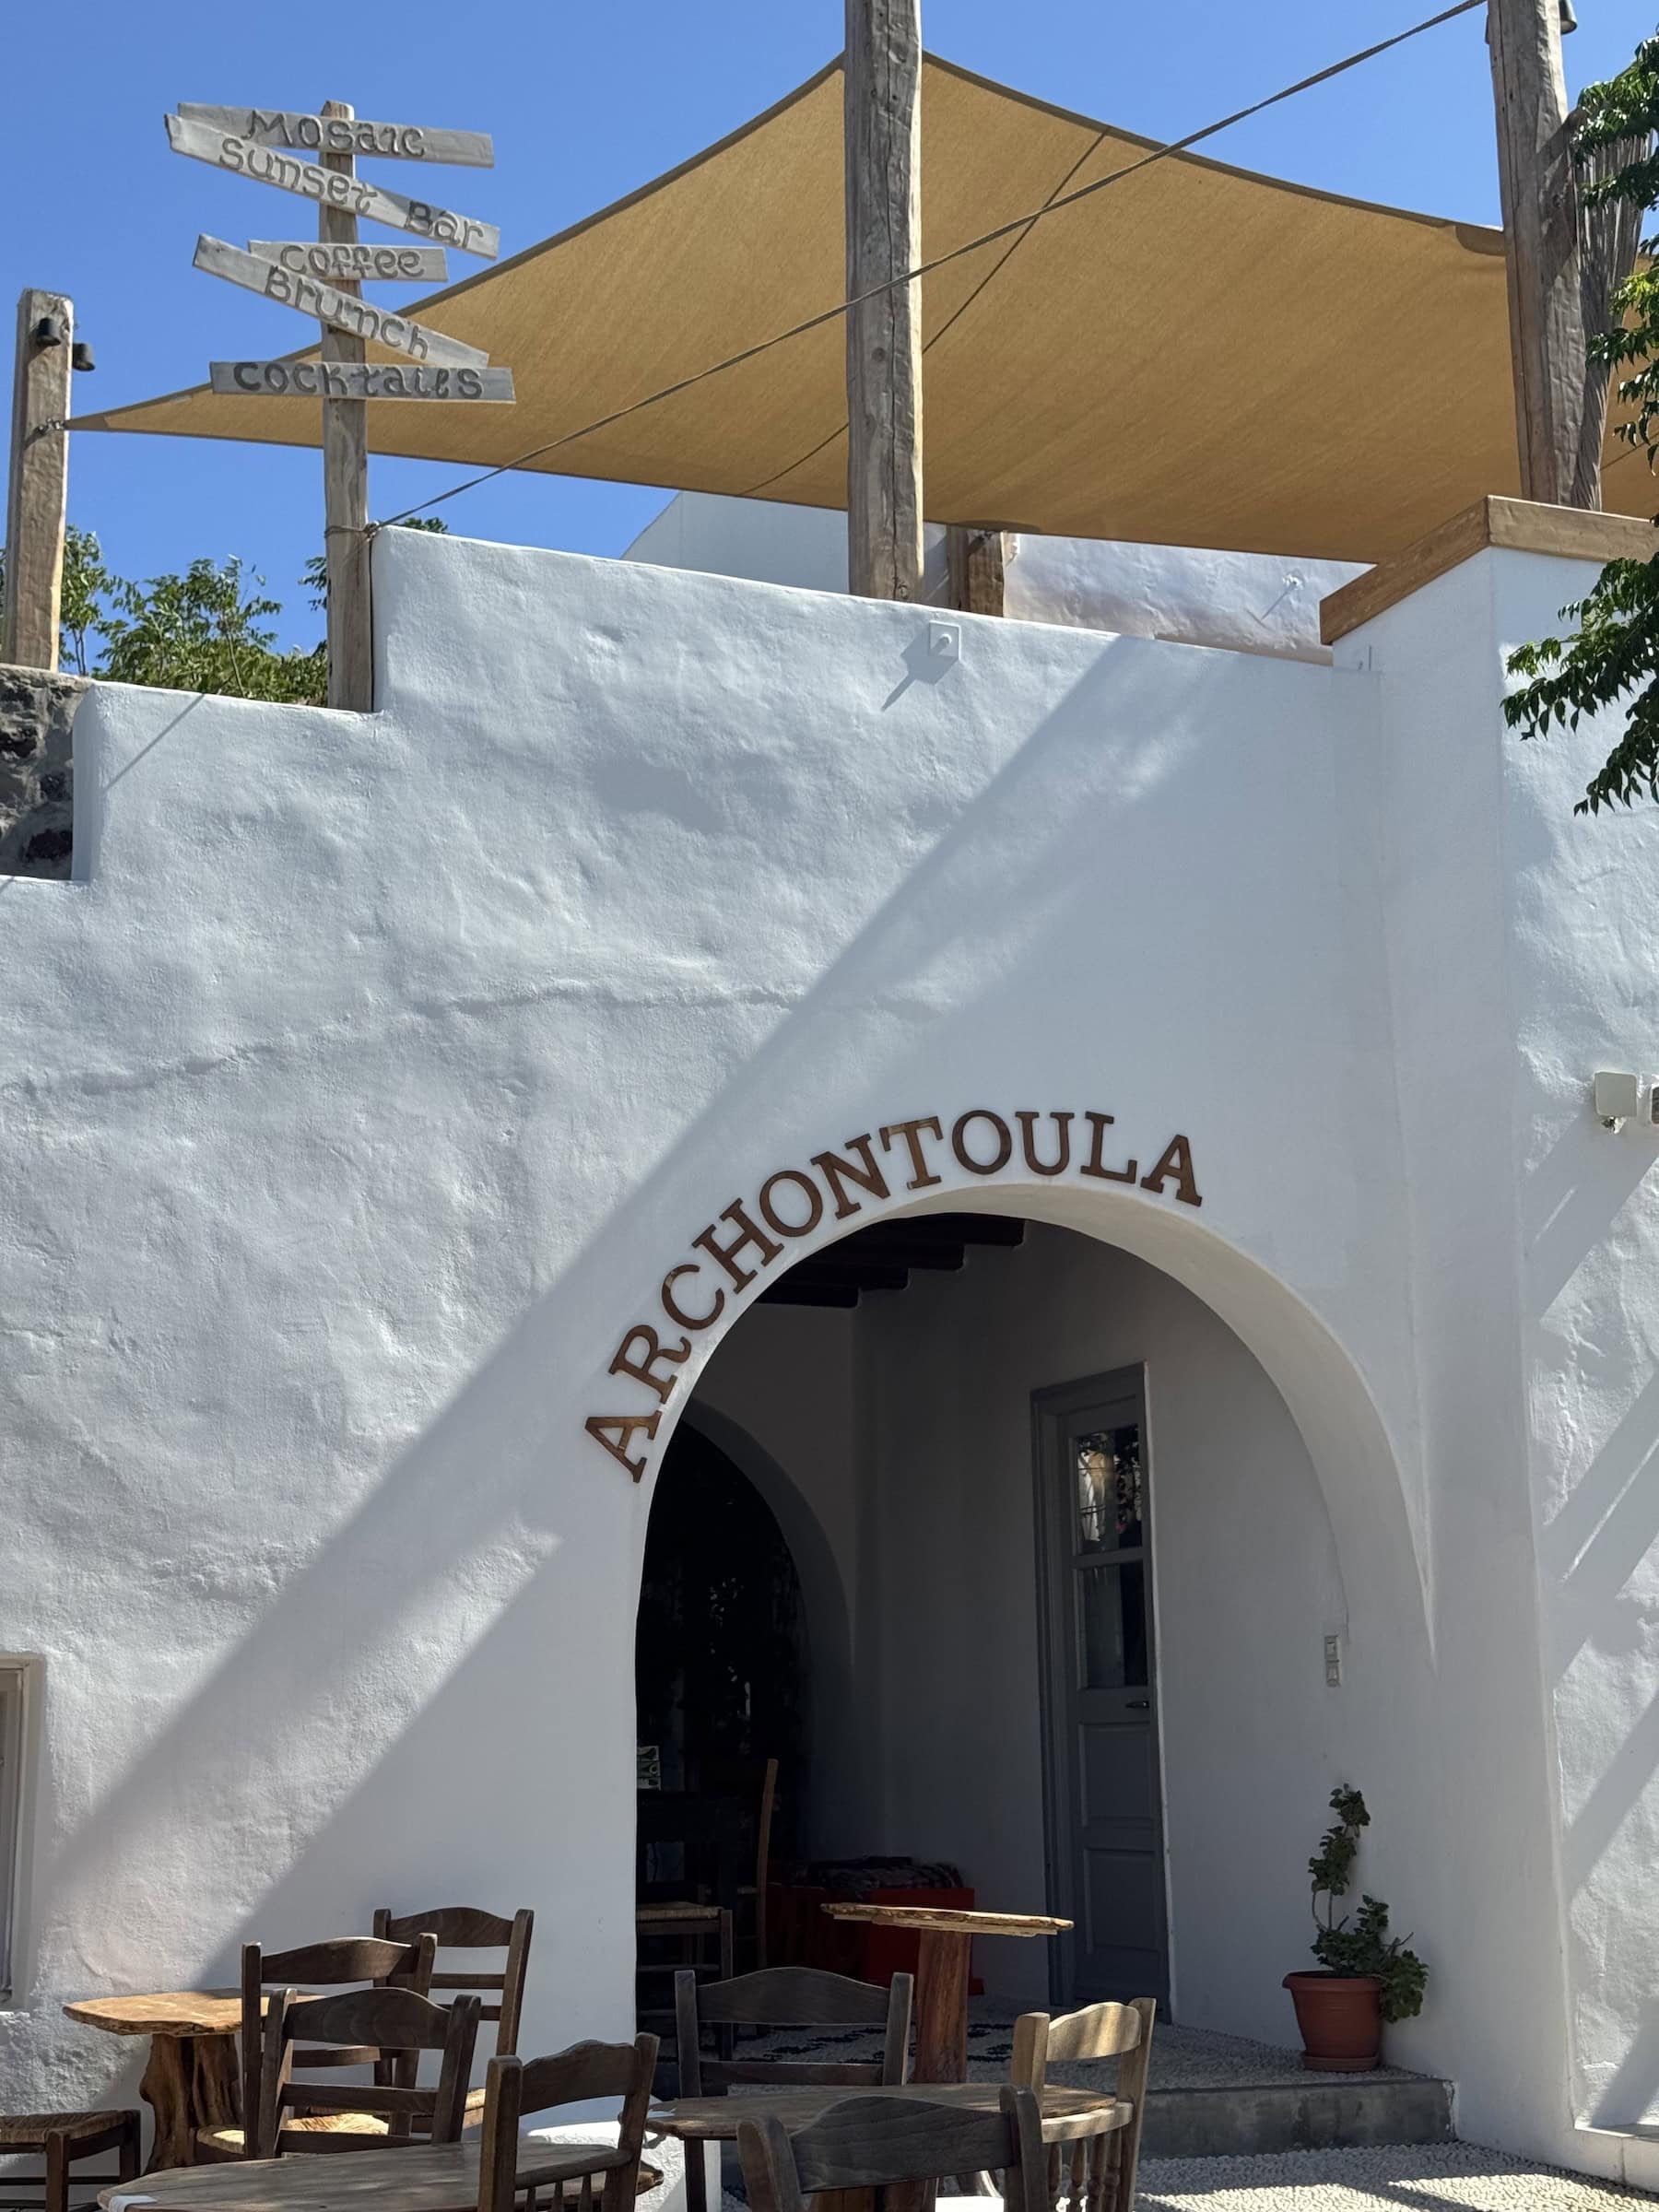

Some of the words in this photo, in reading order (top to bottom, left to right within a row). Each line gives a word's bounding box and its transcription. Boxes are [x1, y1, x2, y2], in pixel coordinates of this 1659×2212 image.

[241, 108, 427, 157] Mosaic
[218, 136, 378, 213] Sunset
[404, 200, 485, 251] Bar
[264, 265, 429, 360] Brunch
[584, 1110, 1202, 1483] ARCHONTOULA
